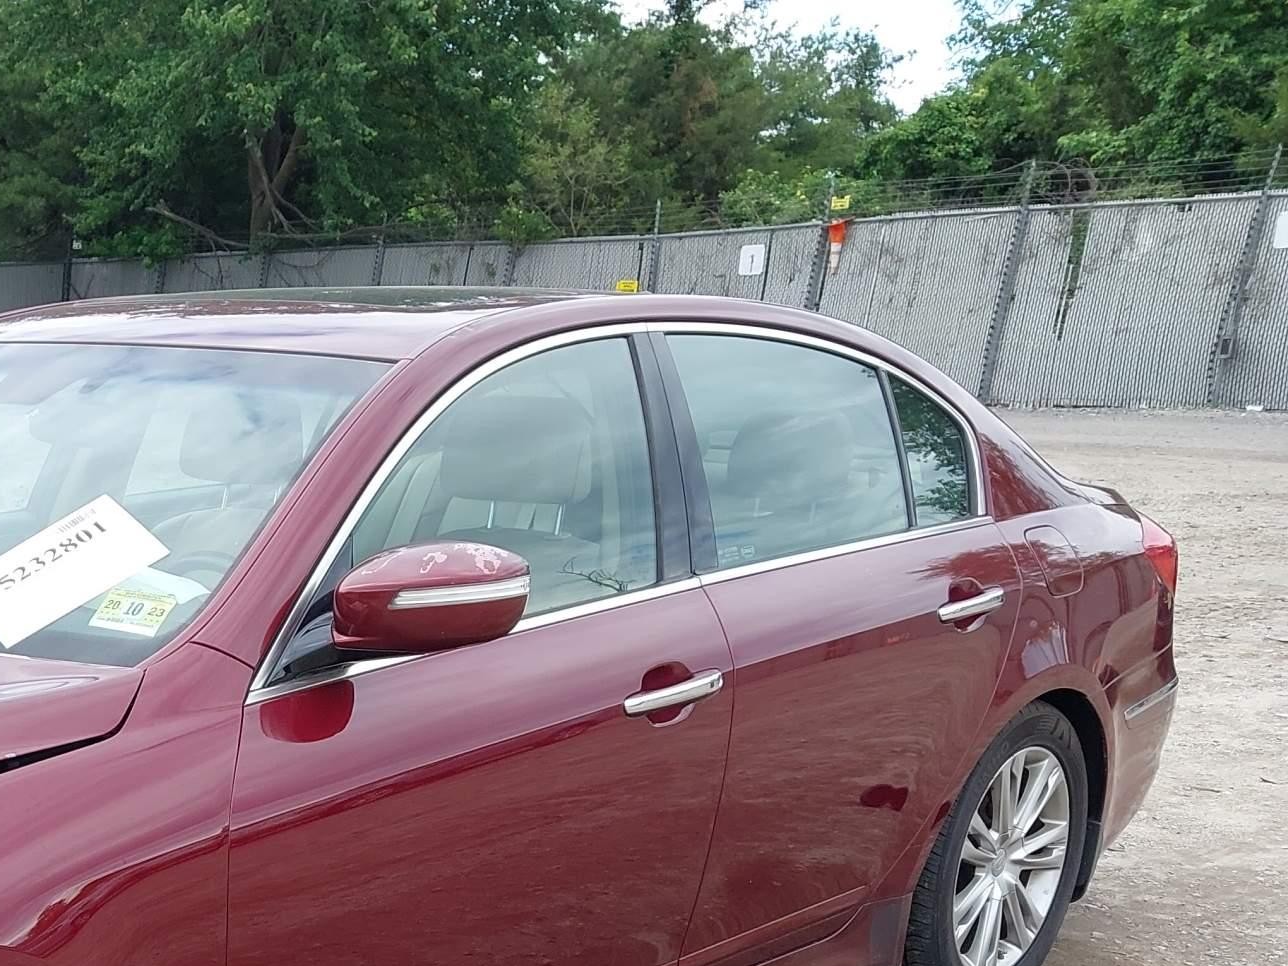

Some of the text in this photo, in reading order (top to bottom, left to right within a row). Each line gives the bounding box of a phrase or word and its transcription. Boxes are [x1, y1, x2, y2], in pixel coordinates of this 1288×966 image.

[103, 599, 166, 617] 20 10 23
